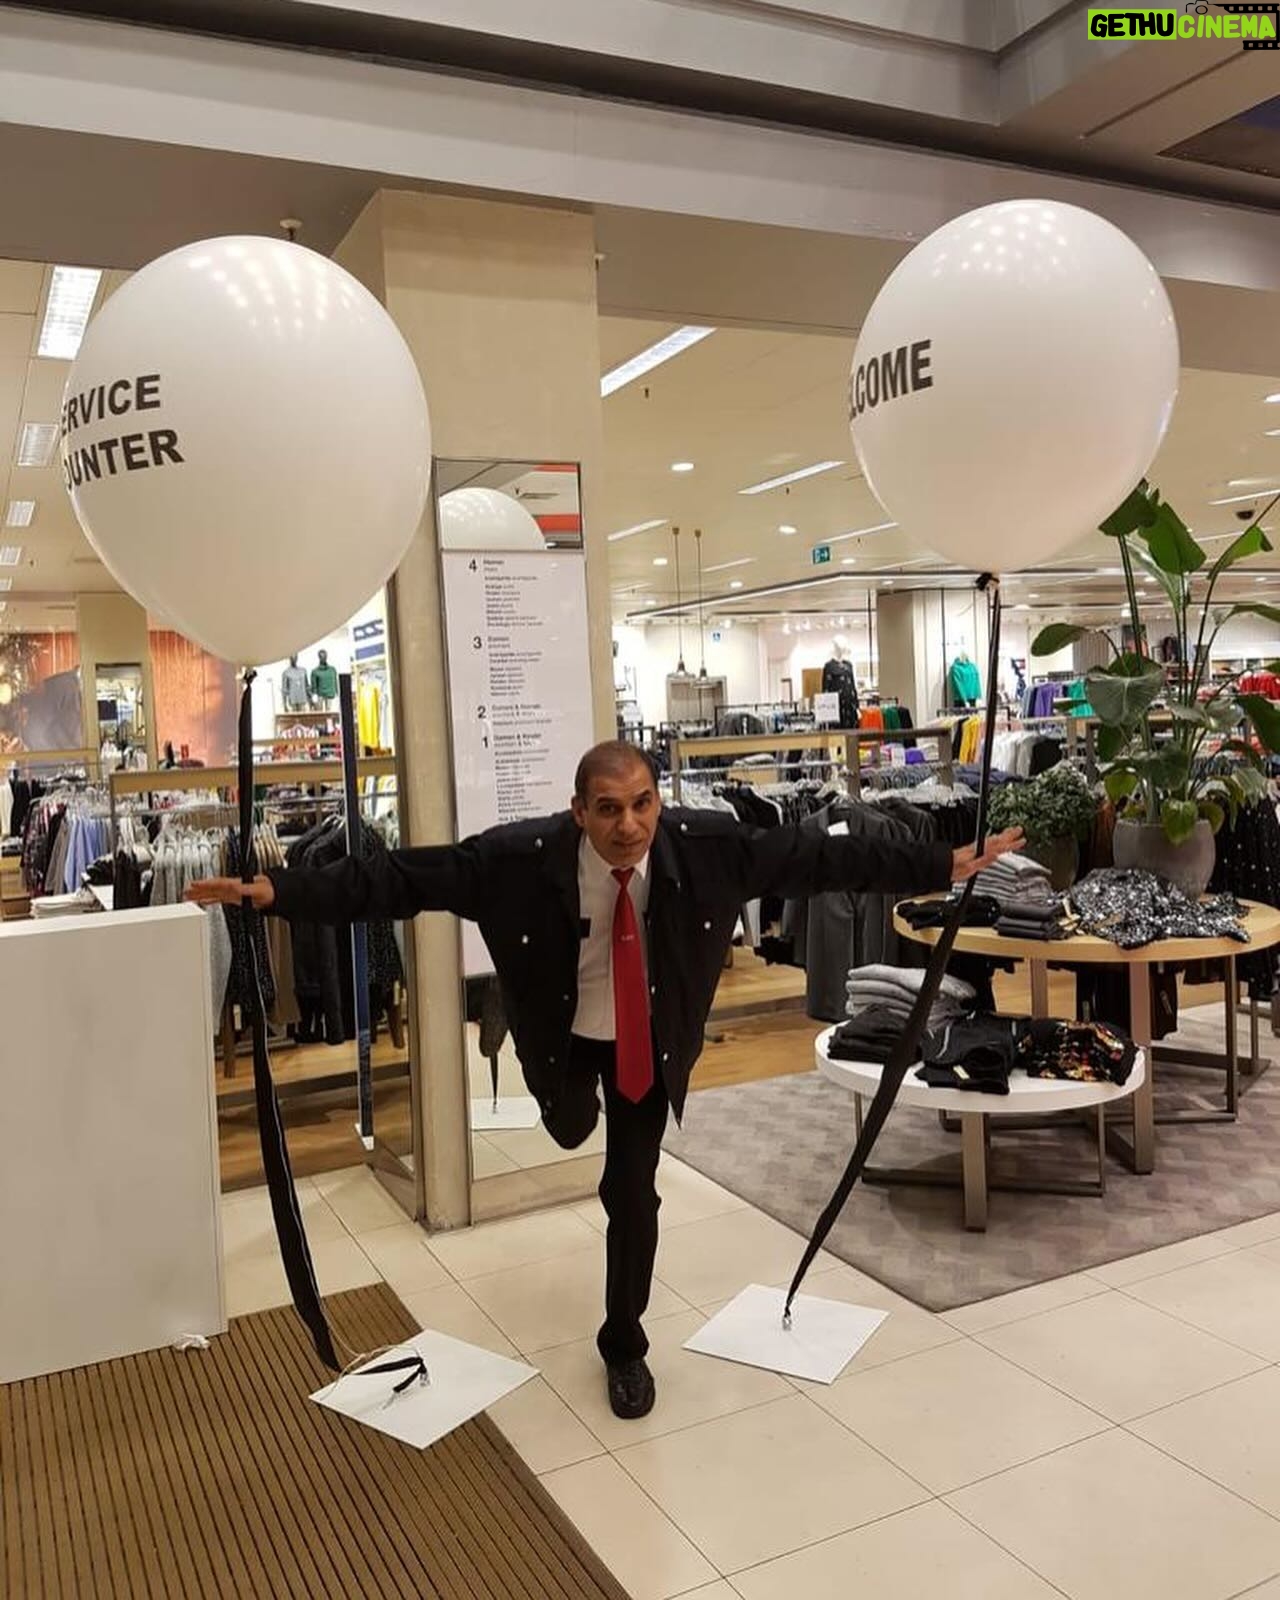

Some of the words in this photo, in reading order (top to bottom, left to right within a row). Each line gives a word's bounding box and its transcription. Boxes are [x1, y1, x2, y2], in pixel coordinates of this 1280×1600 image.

[469, 558, 477, 573] 4
[473, 636, 482, 649] 3
[477, 705, 486, 719] 2
[482, 736, 489, 748] 1
